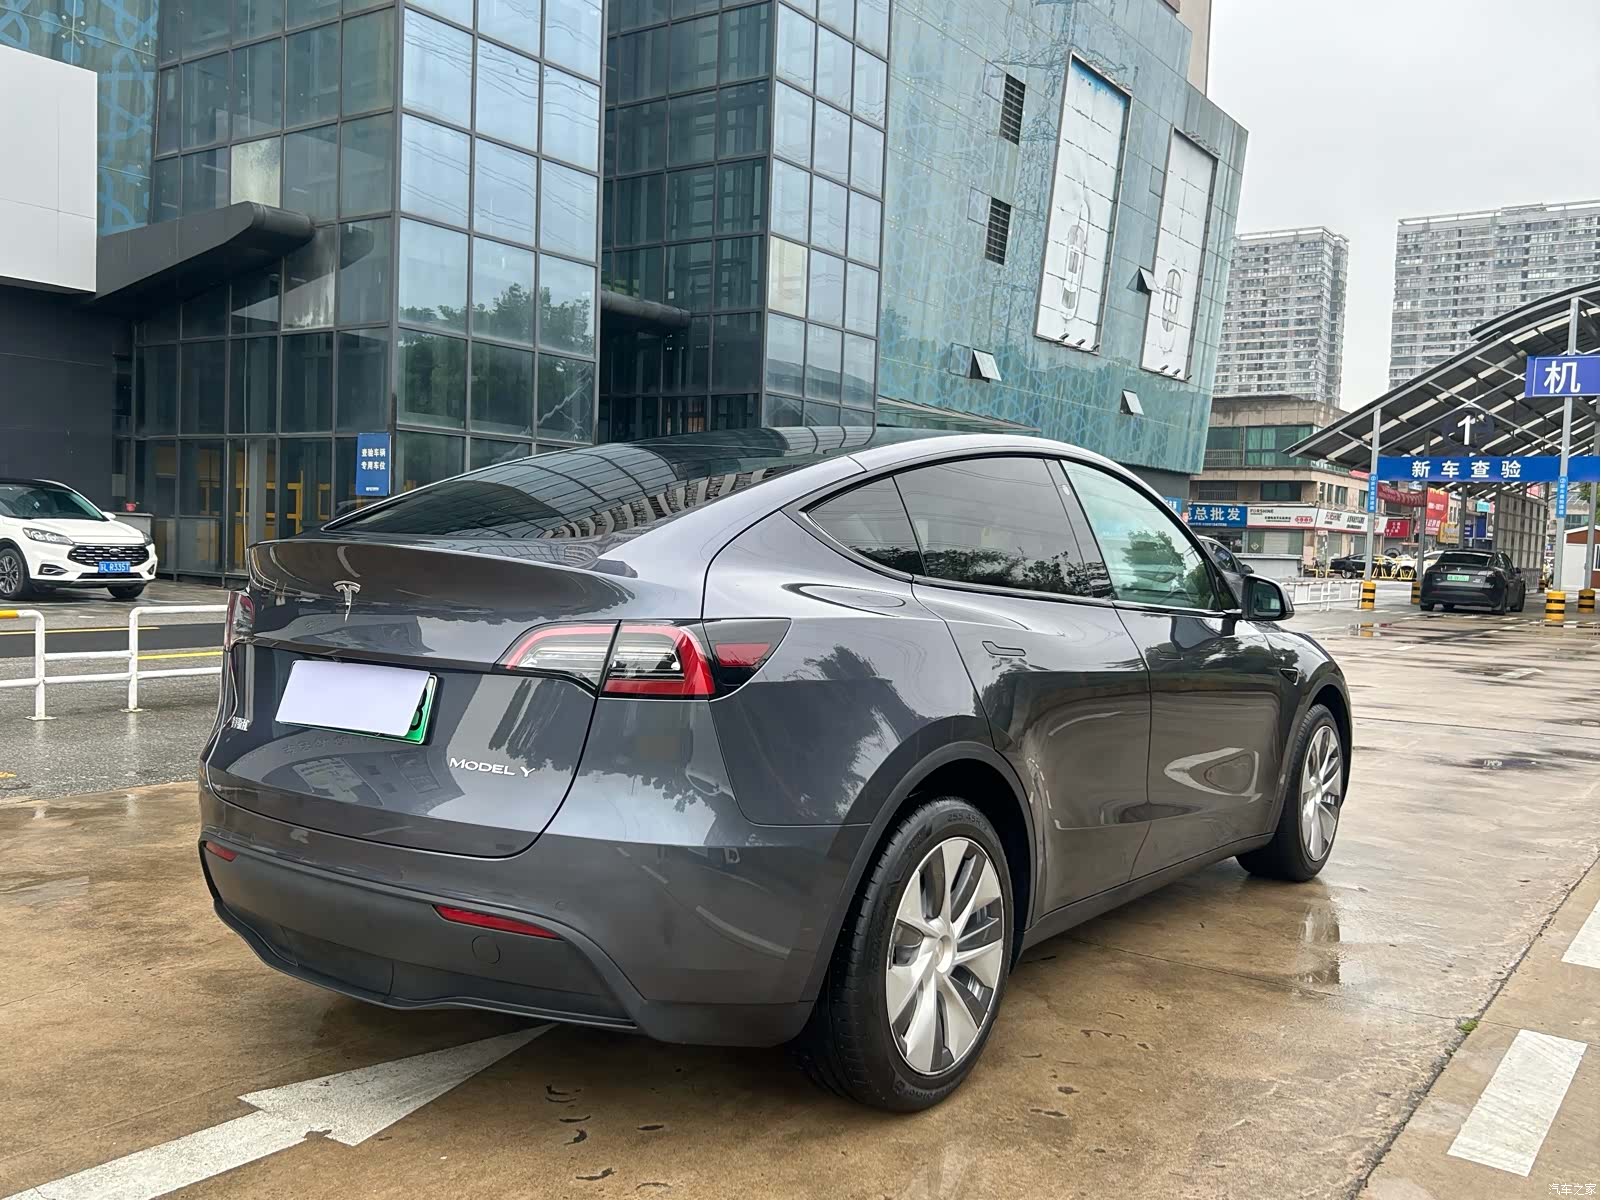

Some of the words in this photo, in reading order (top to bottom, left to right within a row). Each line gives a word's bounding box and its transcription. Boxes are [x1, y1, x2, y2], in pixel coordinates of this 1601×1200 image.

[1543, 360, 1581, 394] 机
[1457, 414, 1471, 446] 1
[1411, 460, 1522, 479] 新车查验
[449, 757, 516, 776] MODEL
[519, 766, 536, 778] Y
